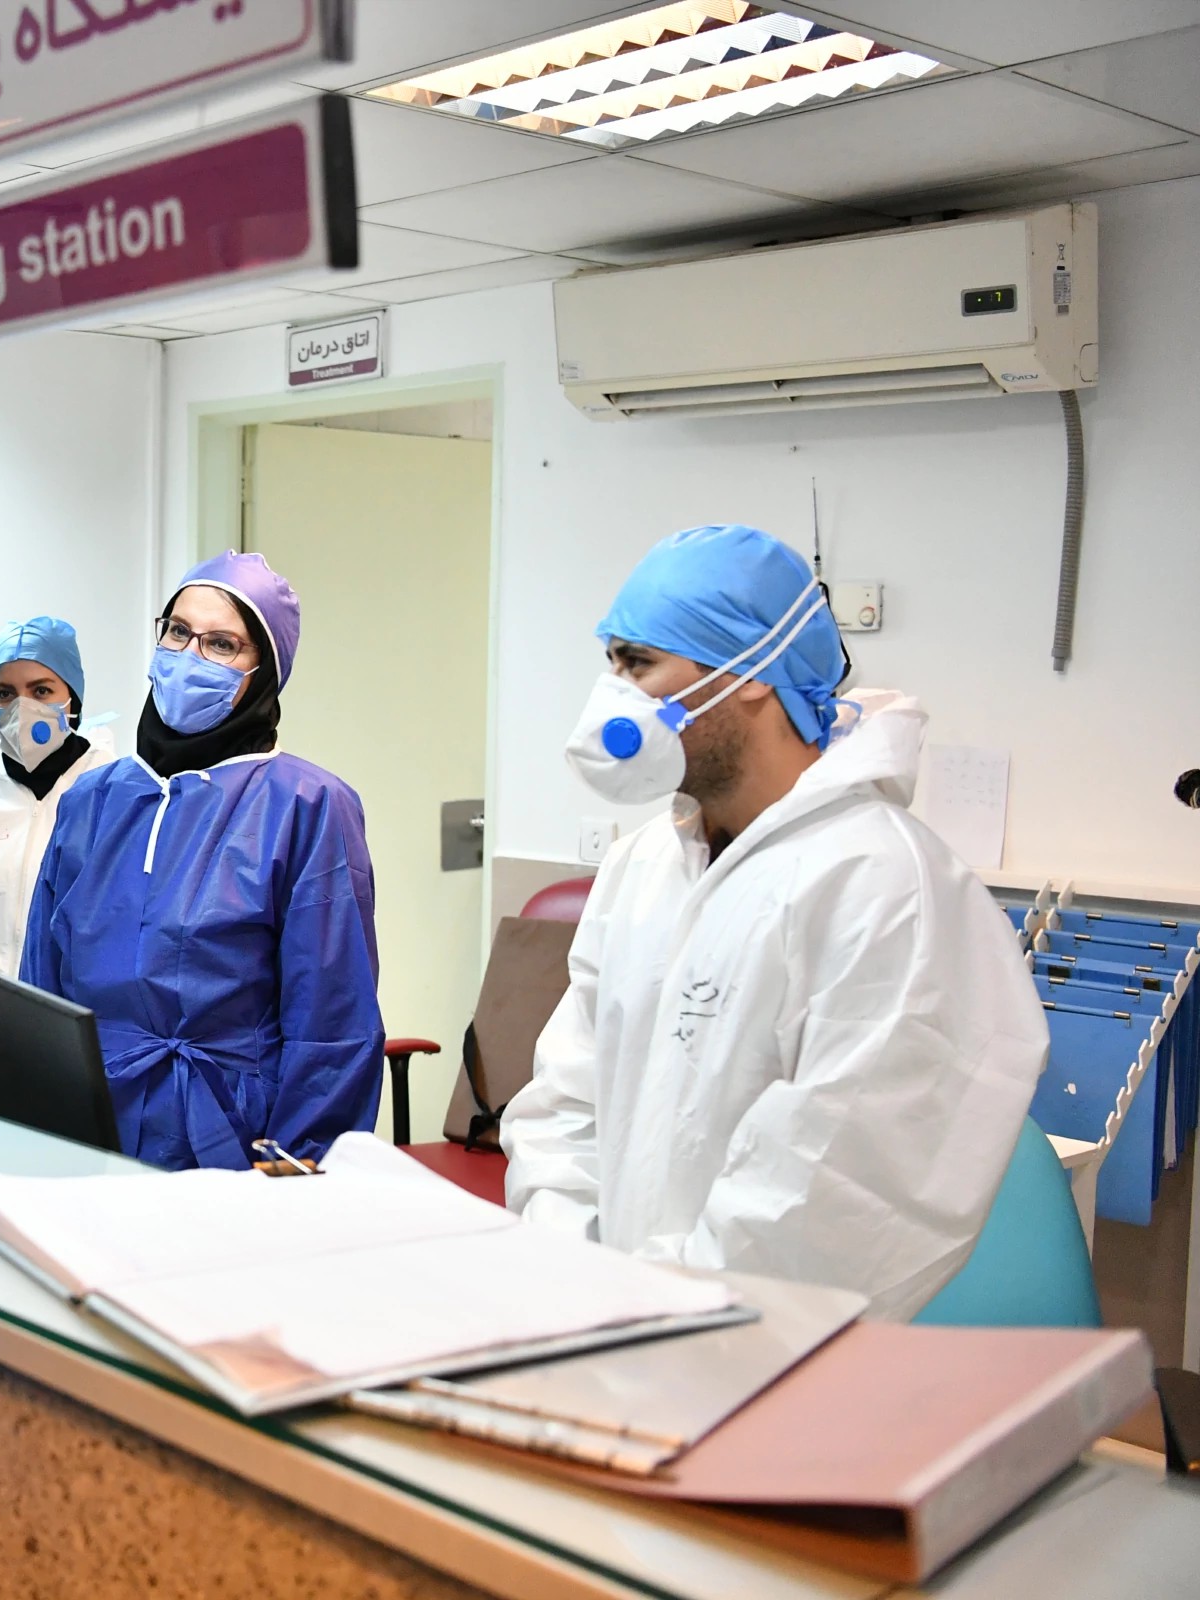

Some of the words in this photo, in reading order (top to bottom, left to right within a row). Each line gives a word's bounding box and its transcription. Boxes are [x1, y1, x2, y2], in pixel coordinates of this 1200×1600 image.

[17, 197, 185, 282] station
[297, 340, 339, 363] درمان
[341, 330, 370, 355] اتاق
